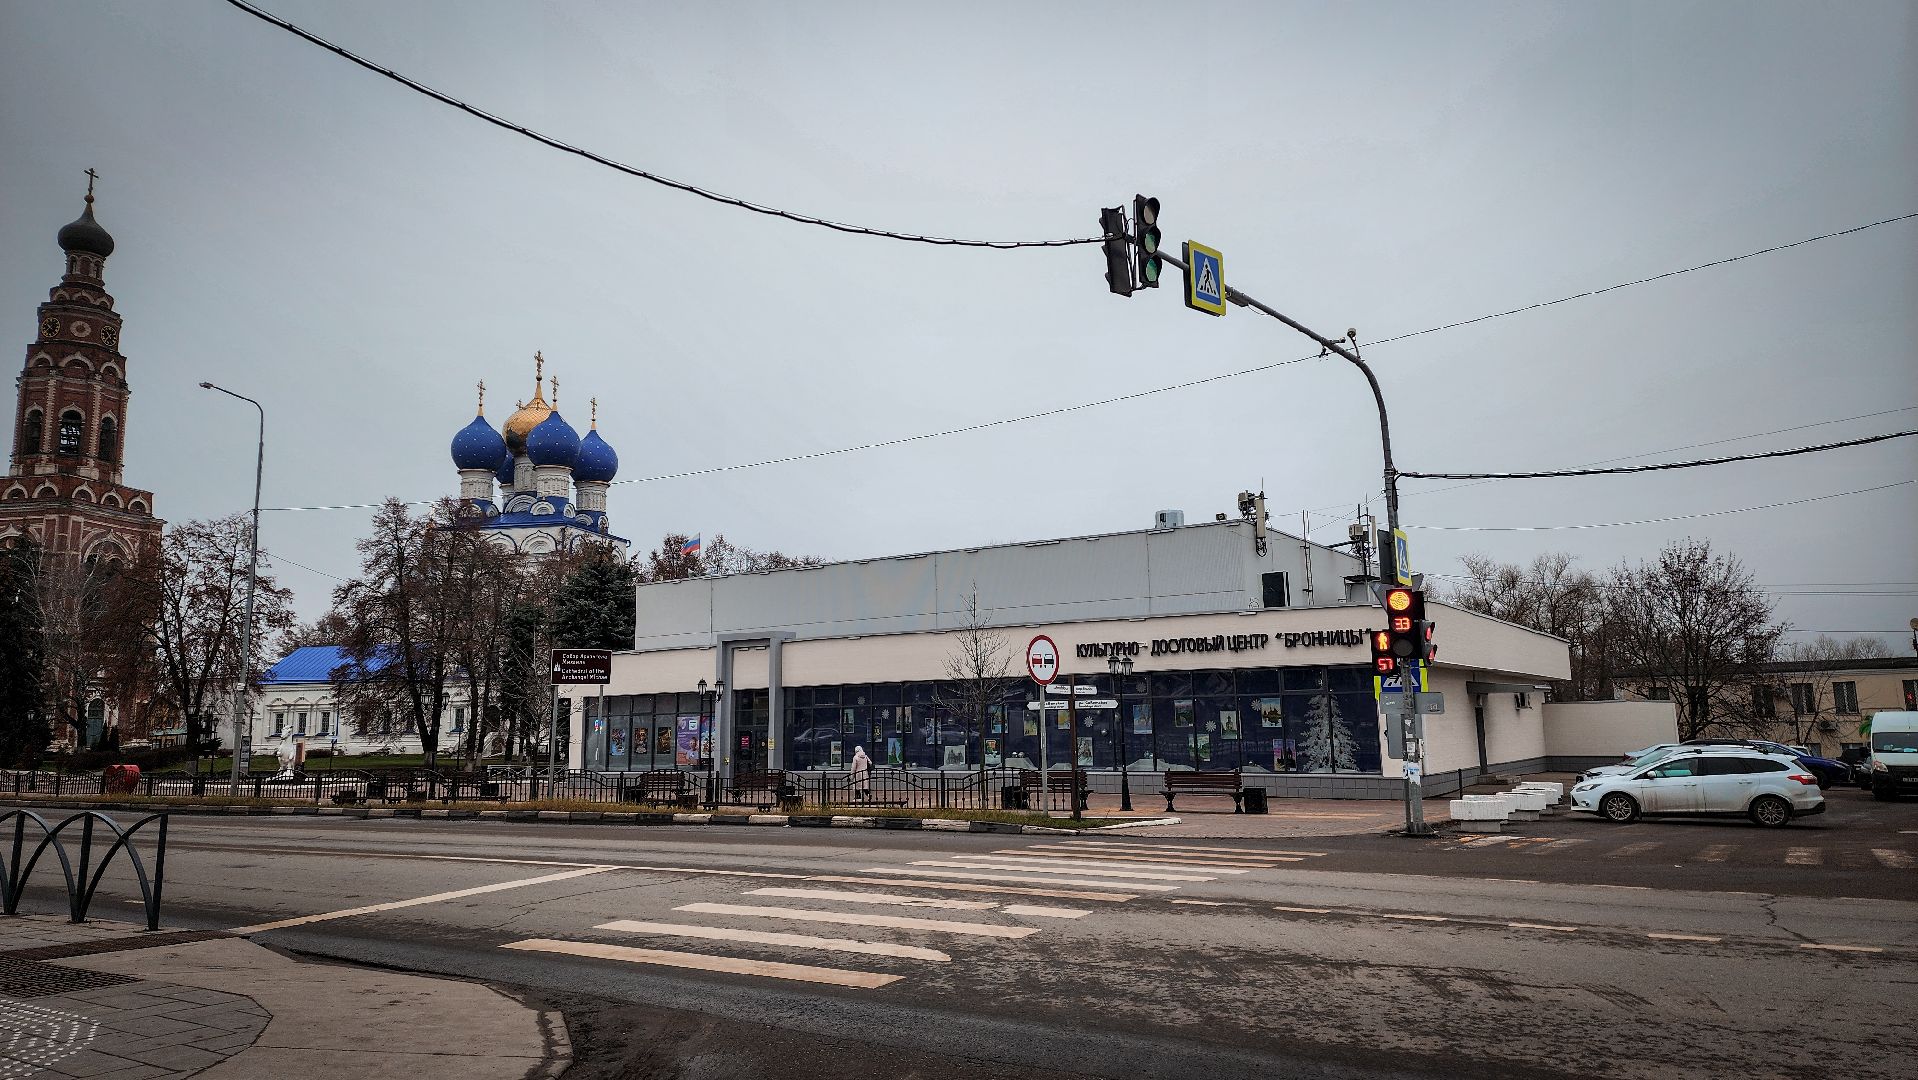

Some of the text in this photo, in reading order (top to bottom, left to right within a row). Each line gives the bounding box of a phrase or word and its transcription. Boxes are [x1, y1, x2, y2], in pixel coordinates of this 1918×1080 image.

[1394, 617, 1410, 630] 33
[1227, 634, 1268, 652] ЦЕНТР
[1378, 658, 1393, 670] 57
